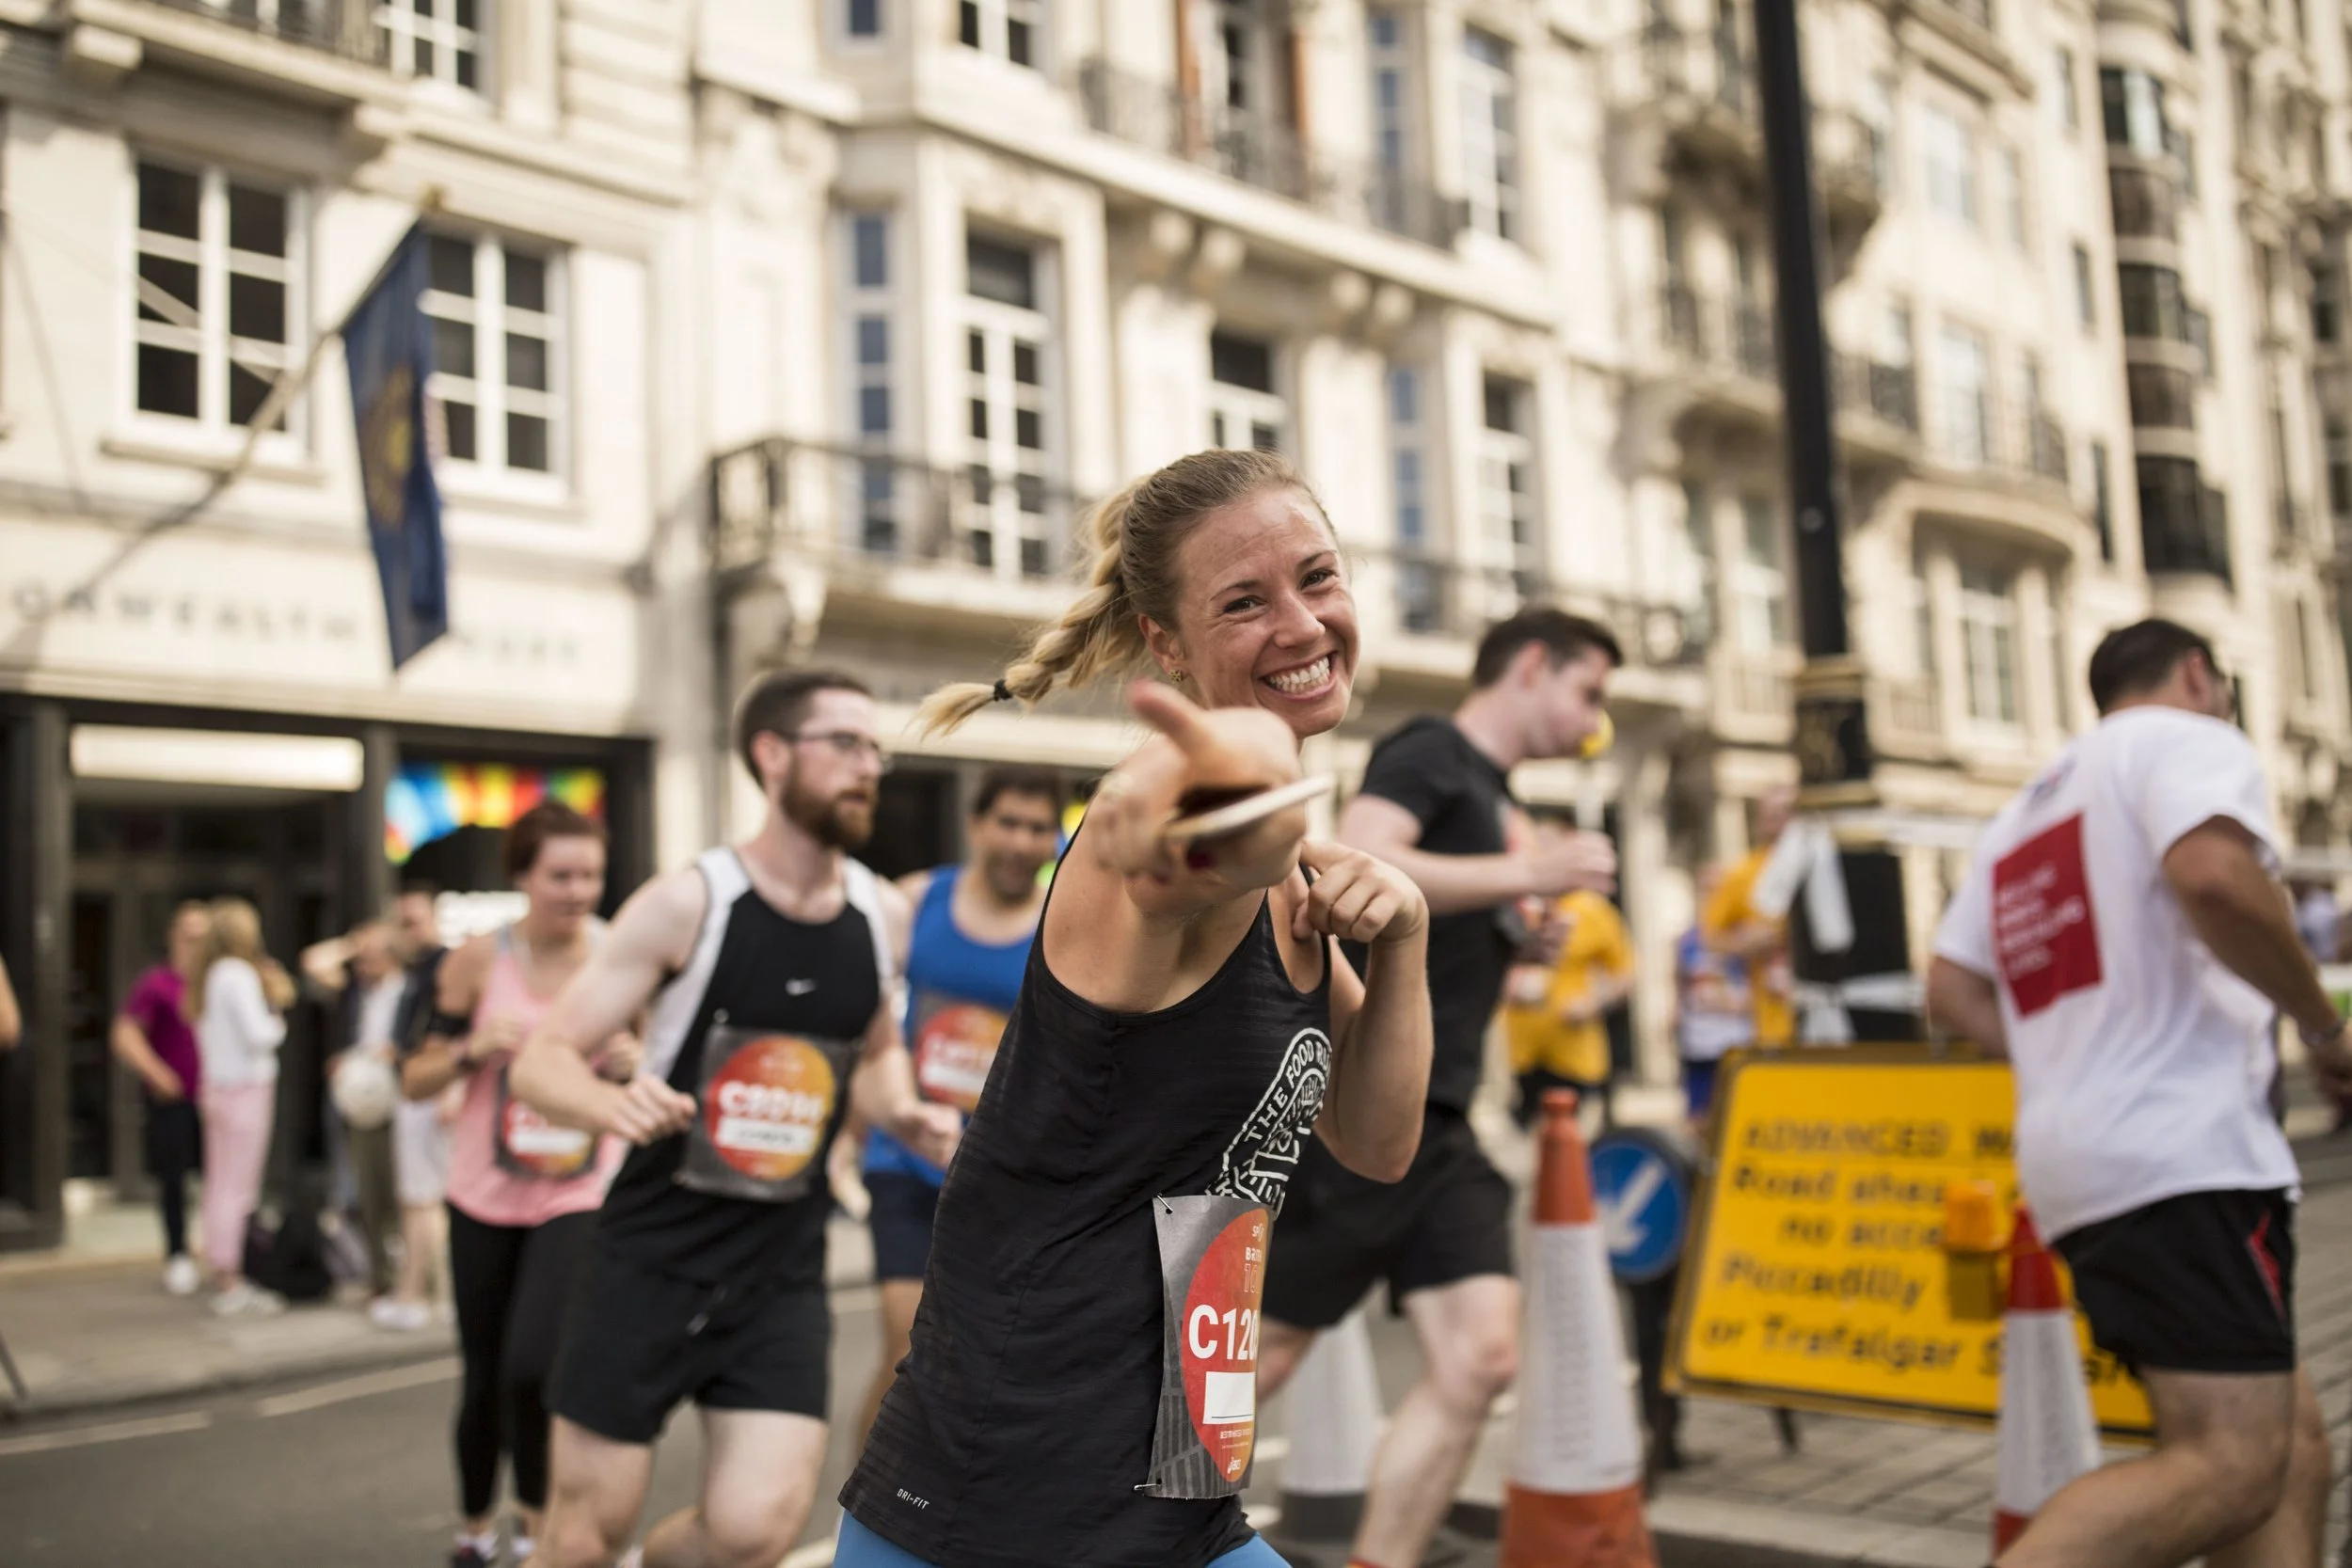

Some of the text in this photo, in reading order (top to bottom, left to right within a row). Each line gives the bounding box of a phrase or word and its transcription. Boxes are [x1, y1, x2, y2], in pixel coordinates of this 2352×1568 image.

[1244, 1086, 1289, 1142] THE
[1285, 1039, 1314, 1089] FOOD
[1847, 1174, 1945, 1208] ahea
[897, 1488, 930, 1510] DRI-FIT
